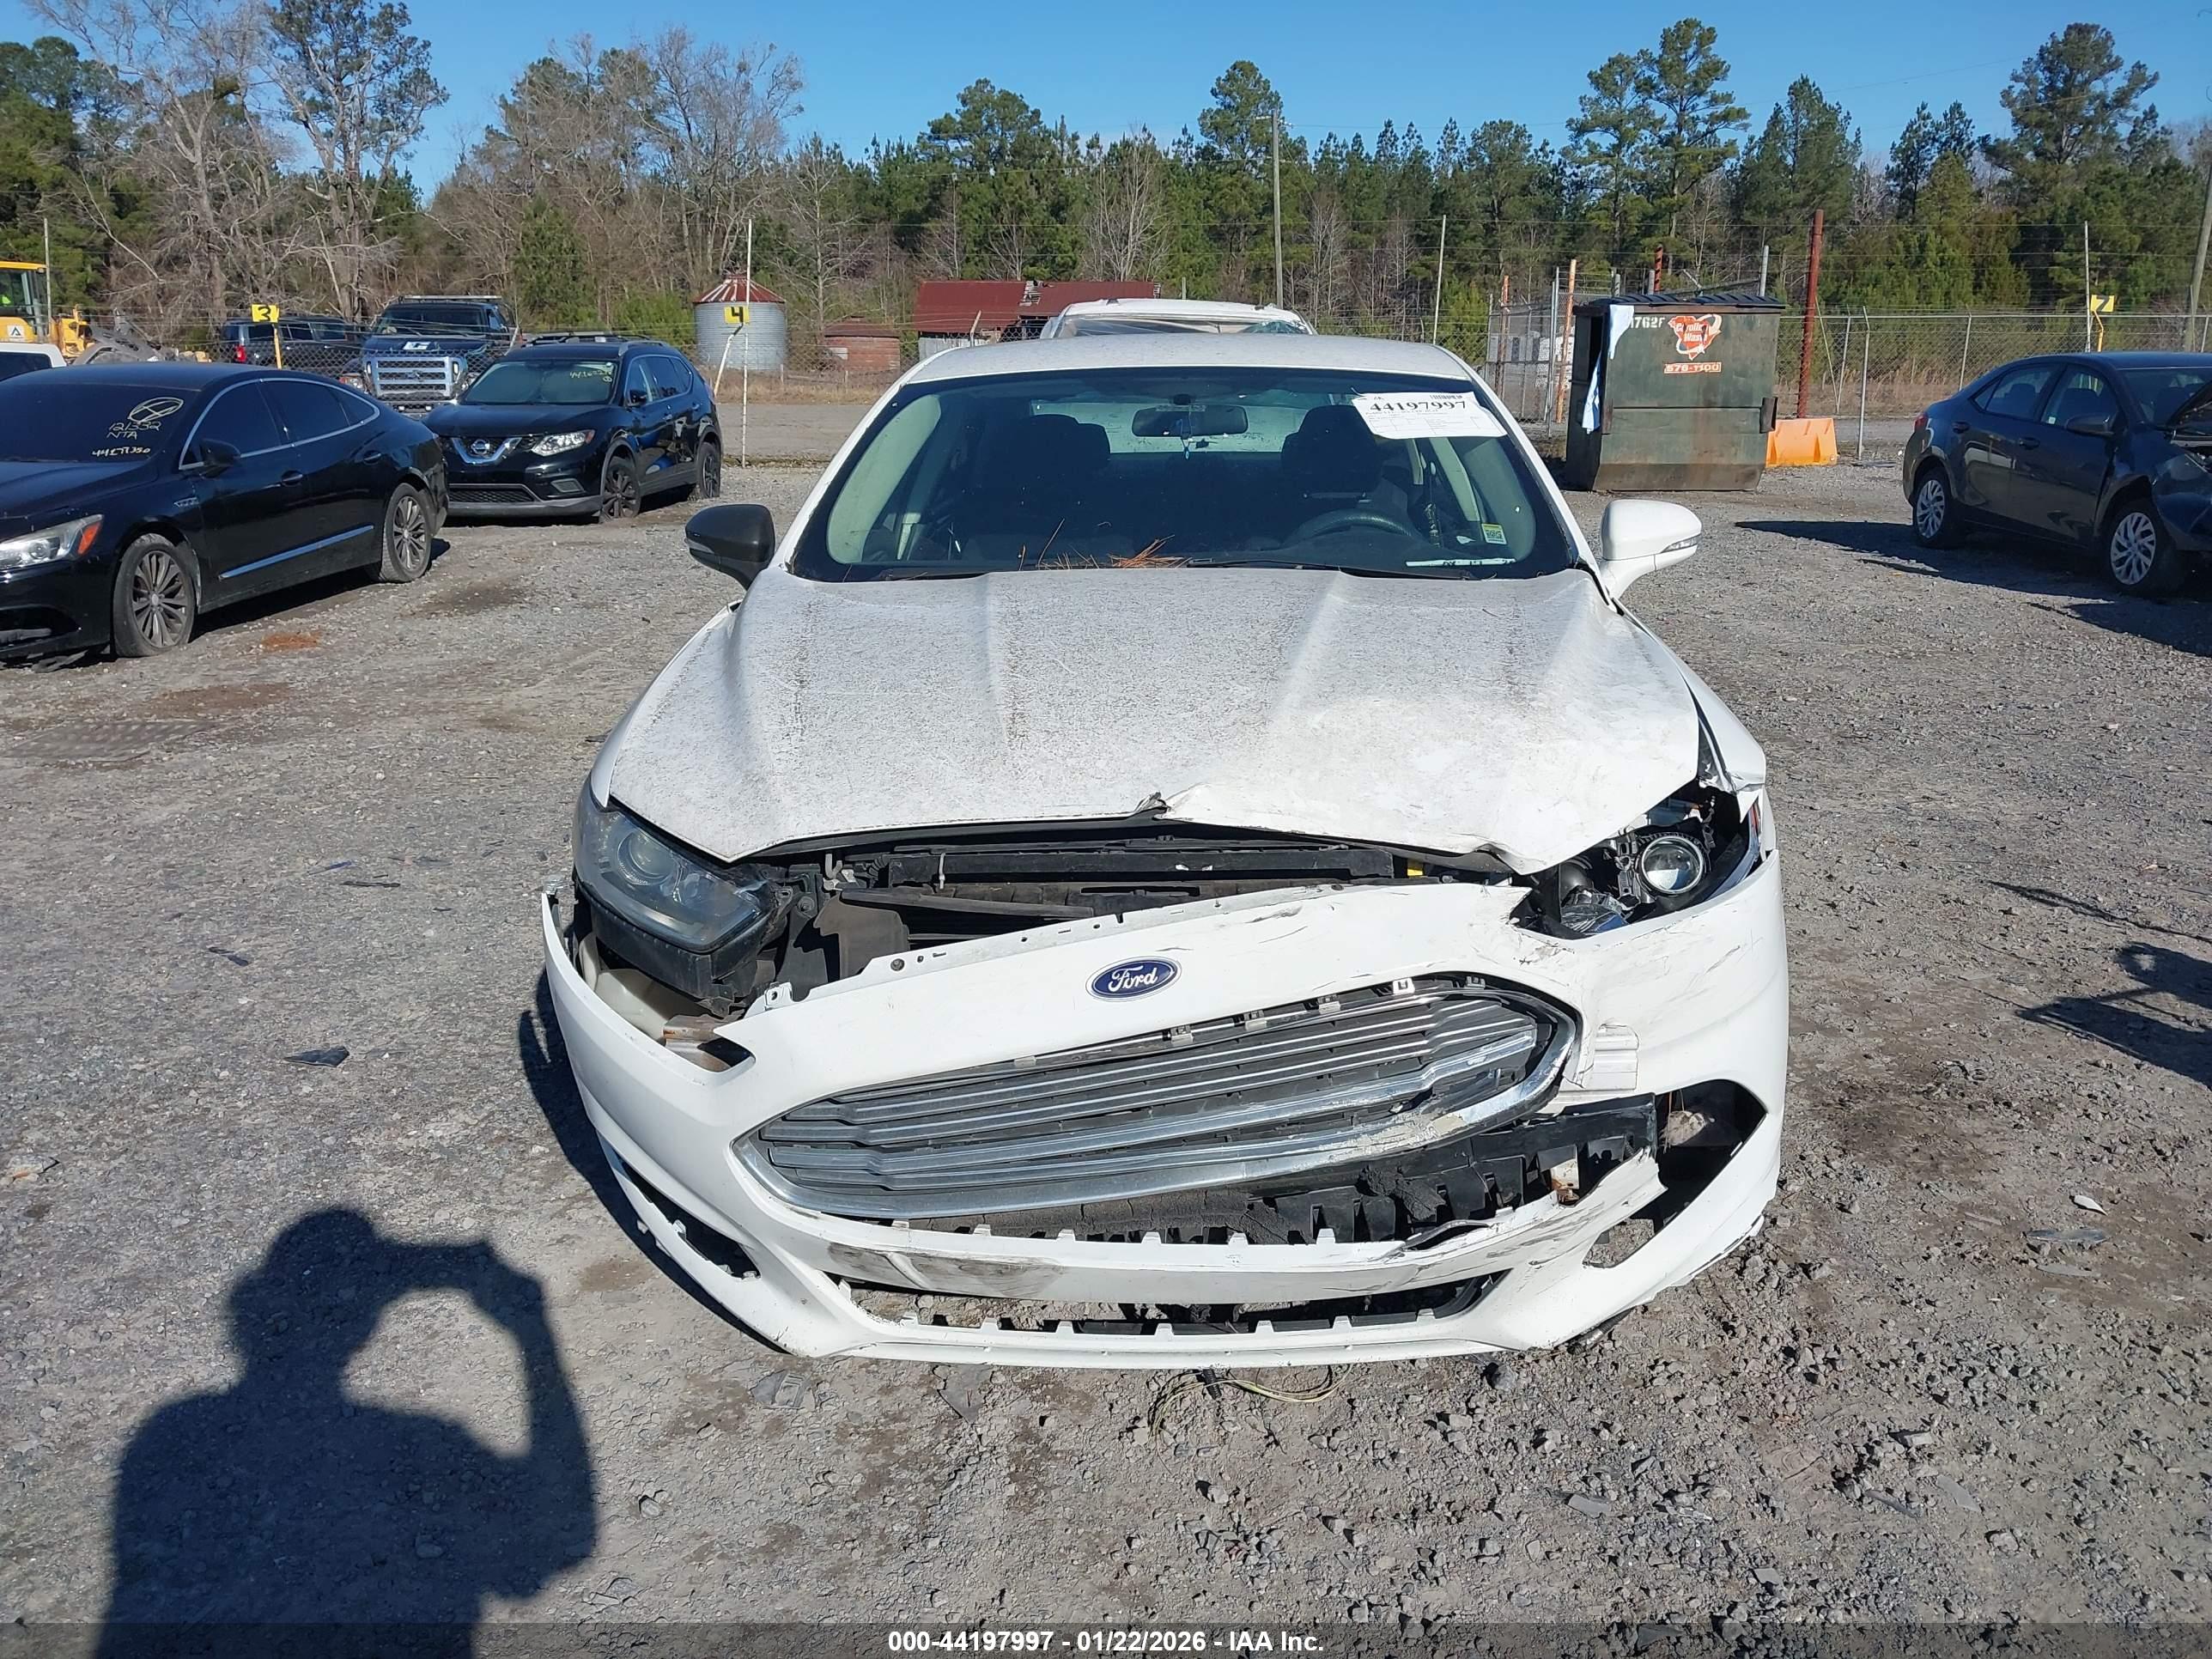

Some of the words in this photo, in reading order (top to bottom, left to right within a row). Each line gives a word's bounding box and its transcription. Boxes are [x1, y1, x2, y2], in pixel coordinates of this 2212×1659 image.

[258, 306, 271, 321] 3
[731, 307, 744, 322] 4
[1370, 400, 1466, 411] 44197997
[106, 431, 137, 440] NTA
[1109, 965, 1158, 992] Ford
